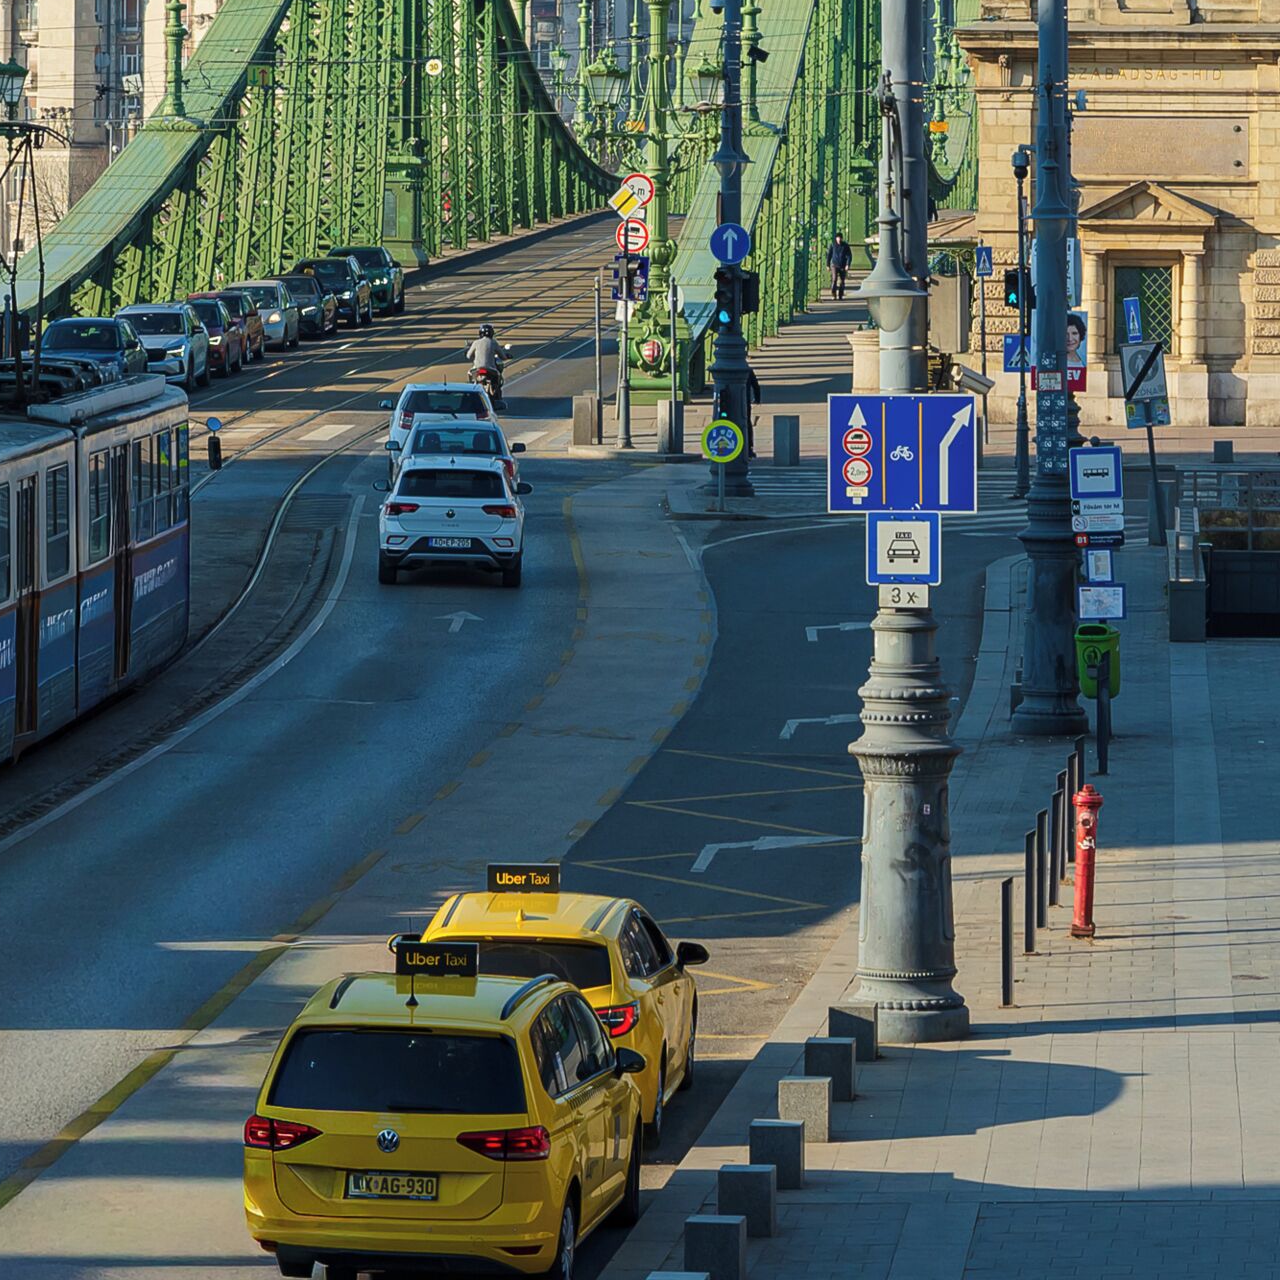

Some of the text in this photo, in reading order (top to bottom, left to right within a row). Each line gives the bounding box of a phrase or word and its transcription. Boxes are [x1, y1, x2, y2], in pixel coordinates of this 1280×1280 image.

[891, 587, 916, 609] 3 x
[496, 872, 550, 885] Uber Taxi
[405, 952, 468, 966] Uber Taxi
[380, 1177, 434, 1195] AG-930
